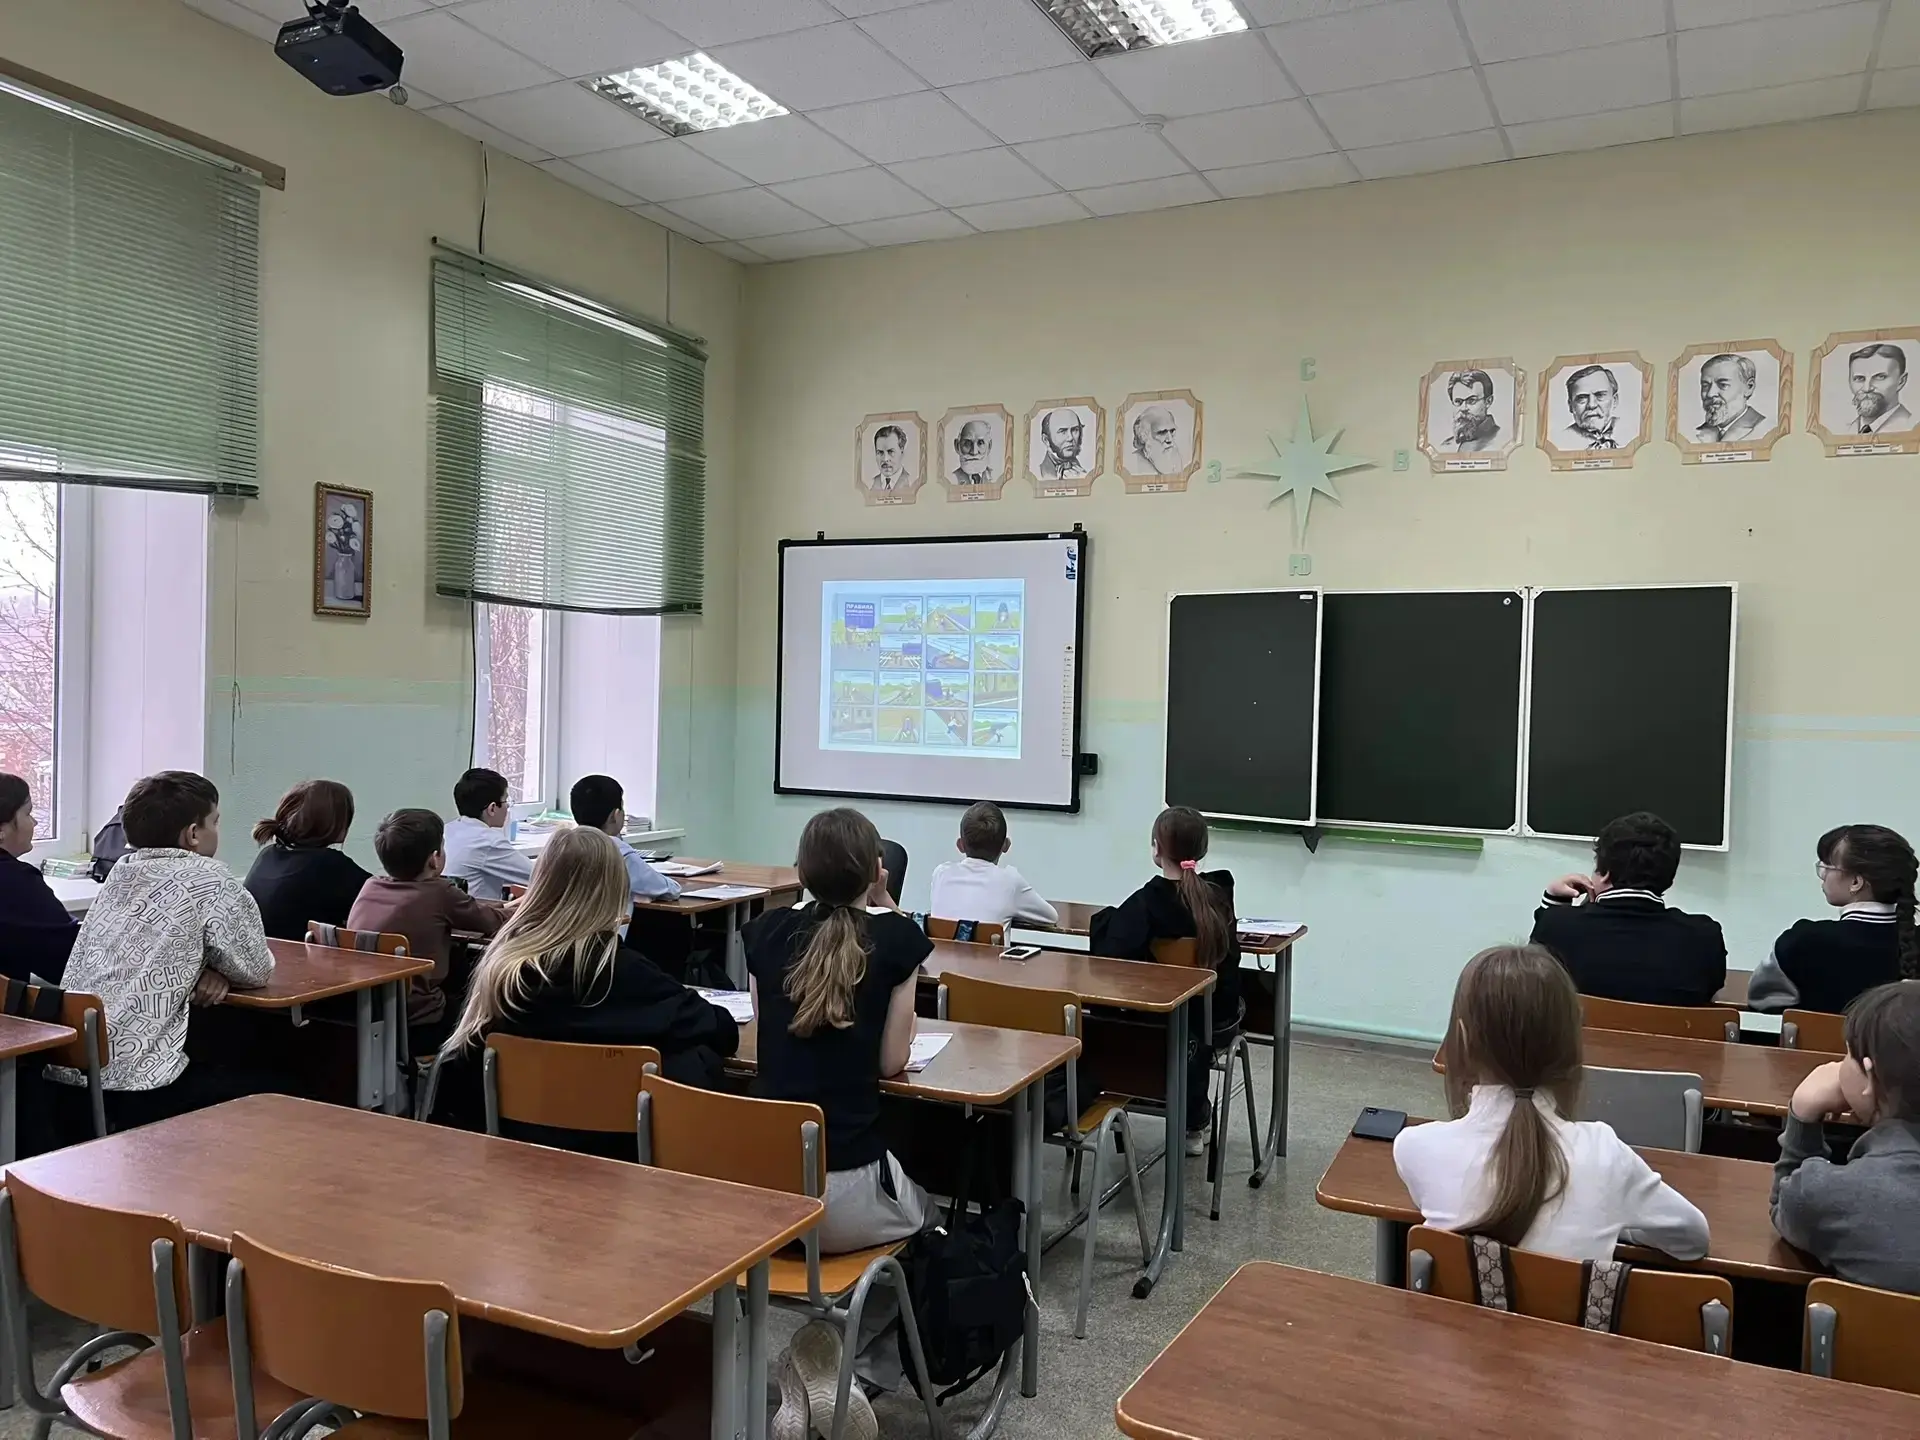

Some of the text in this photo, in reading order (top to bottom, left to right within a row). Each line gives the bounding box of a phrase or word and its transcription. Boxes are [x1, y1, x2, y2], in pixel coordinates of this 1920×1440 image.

[1300, 357, 1316, 382] С
[1206, 459, 1222, 483] З
[1393, 449, 1410, 472] В
[1289, 553, 1312, 576] Ю
